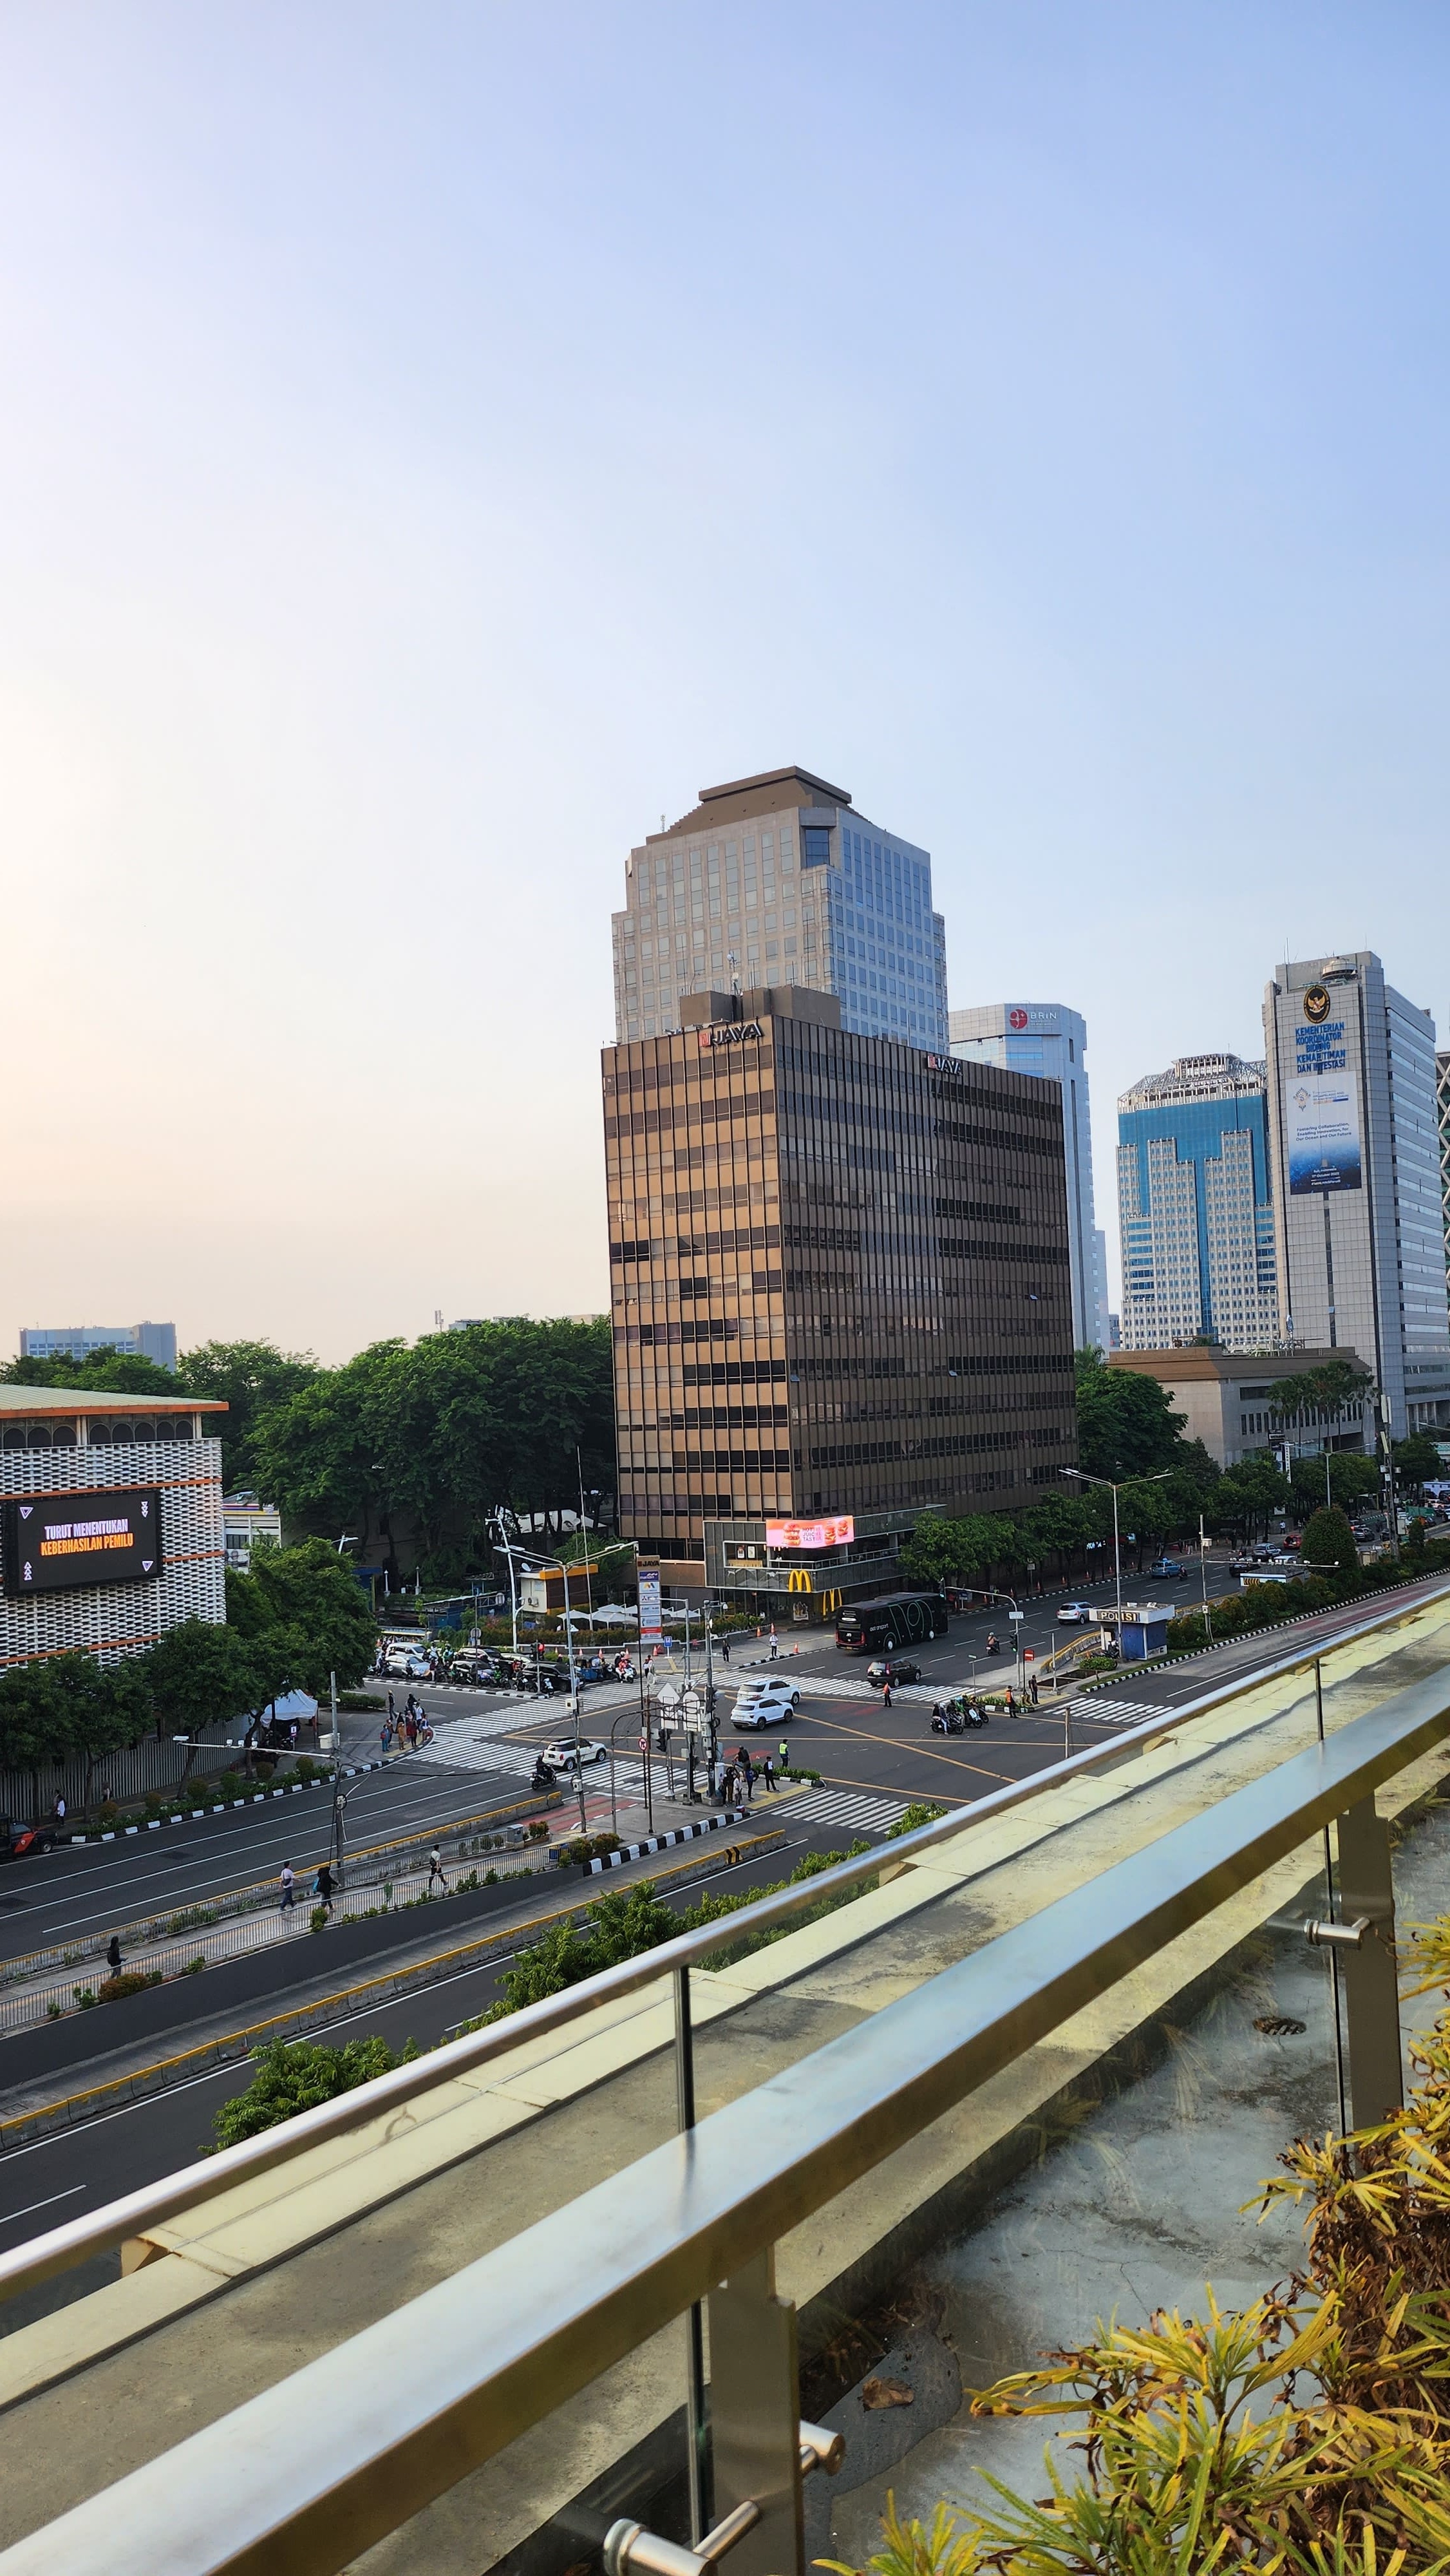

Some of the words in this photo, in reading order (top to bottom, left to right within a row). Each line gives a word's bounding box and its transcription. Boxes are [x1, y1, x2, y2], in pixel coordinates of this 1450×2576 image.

[712, 1022, 762, 1045] JAYA
[1295, 1021, 1344, 1037] KEMENTERIAN
[1296, 1032, 1342, 1046] KOORDINATOR
[1297, 1063, 1312, 1074] DAN
[44, 1524, 73, 1540] TURUT
[73, 1519, 128, 1537] MENENTUKAN
[41, 1537, 102, 1556] KEBERHASILAN
[103, 1533, 133, 1549] PEMILU
[1101, 1612, 1137, 1622] POLISI
